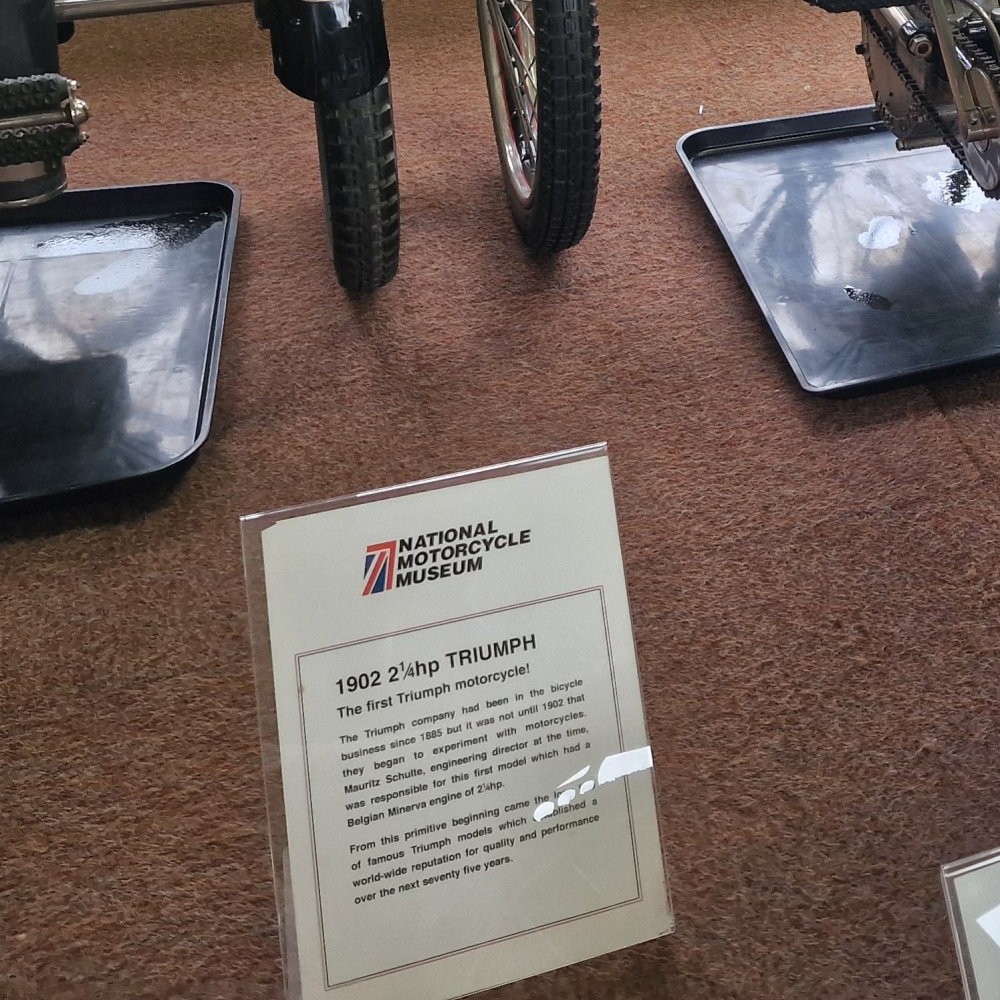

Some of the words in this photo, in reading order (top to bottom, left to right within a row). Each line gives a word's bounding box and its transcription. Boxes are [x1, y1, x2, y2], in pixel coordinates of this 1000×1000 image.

[397, 529, 531, 570] MOTORCYCLE
[399, 521, 498, 552] NATIONAL
[396, 556, 483, 588] MUSEUM
[335, 670, 382, 695] 1902
[445, 634, 536, 668] TRIUMPH
[336, 705, 362, 719] The
[365, 695, 393, 712] first
[395, 682, 451, 704] Triumph
[454, 662, 530, 691] motorcycle!
[338, 734, 358, 744] The
[363, 721, 405, 738] Triumph
[411, 710, 455, 727] company
[461, 702, 480, 715] had
[485, 697, 509, 709] been
[514, 693, 524, 701] in
[529, 688, 545, 698] the
[550, 678, 583, 693] bicycle
[340, 744, 386, 761] business
[389, 736, 416, 749] since
[420, 728, 443, 741] 1885
[446, 723, 462, 735] but
[465, 721, 472, 730] it
[475, 717, 495, 727] was
[498, 710, 514, 722] not
[517, 704, 539, 717] until
[542, 698, 564, 711] 1902
[566, 693, 585, 705] that
[342, 766, 365, 778] they
[373, 756, 405, 770] began
[413, 751, 424, 760] to
[432, 733, 488, 755] experiment
[496, 726, 517, 739] with
[525, 711, 587, 731] motorcycles.
[343, 779, 381, 794] Mauritz
[429, 751, 487, 772] engineering
[491, 741, 528, 756] director
[533, 736, 542, 746] at
[546, 732, 562, 742] the
[344, 800, 366, 811] was
[370, 783, 428, 805] responsible
[432, 778, 446, 789] for
[450, 772, 469, 783] this
[473, 765, 493, 777] first
[497, 756, 527, 772] model
[530, 749, 559, 763] which
[563, 742, 581, 754] had
[585, 741, 591, 749] a
[346, 812, 385, 828] Belgian
[387, 801, 427, 817] Minerva
[428, 791, 462, 806] engine
[464, 786, 474, 797] of
[349, 841, 376, 854] From
[380, 834, 400, 846] this
[404, 822, 447, 842] primitive
[451, 807, 500, 827] beginning
[504, 800, 530, 813] came
[533, 795, 549, 805] the
[351, 859, 361, 871] of
[367, 850, 405, 866] famous
[410, 836, 451, 854] Triumph
[457, 826, 493, 842] models
[498, 816, 527, 831] which
[533, 800, 586, 820] blished
[591, 798, 598, 806] a
[352, 866, 407, 888] world-wide
[411, 852, 461, 872] reputation
[465, 847, 479, 857] for
[482, 837, 515, 853] quality
[519, 829, 537, 842] and
[540, 814, 599, 838] performance
[354, 892, 377, 905] over
[379, 887, 396, 898] the
[398, 879, 420, 893] next
[422, 869, 460, 886] seventy
[462, 864, 481, 875] five
[483, 856, 513, 871] years.
